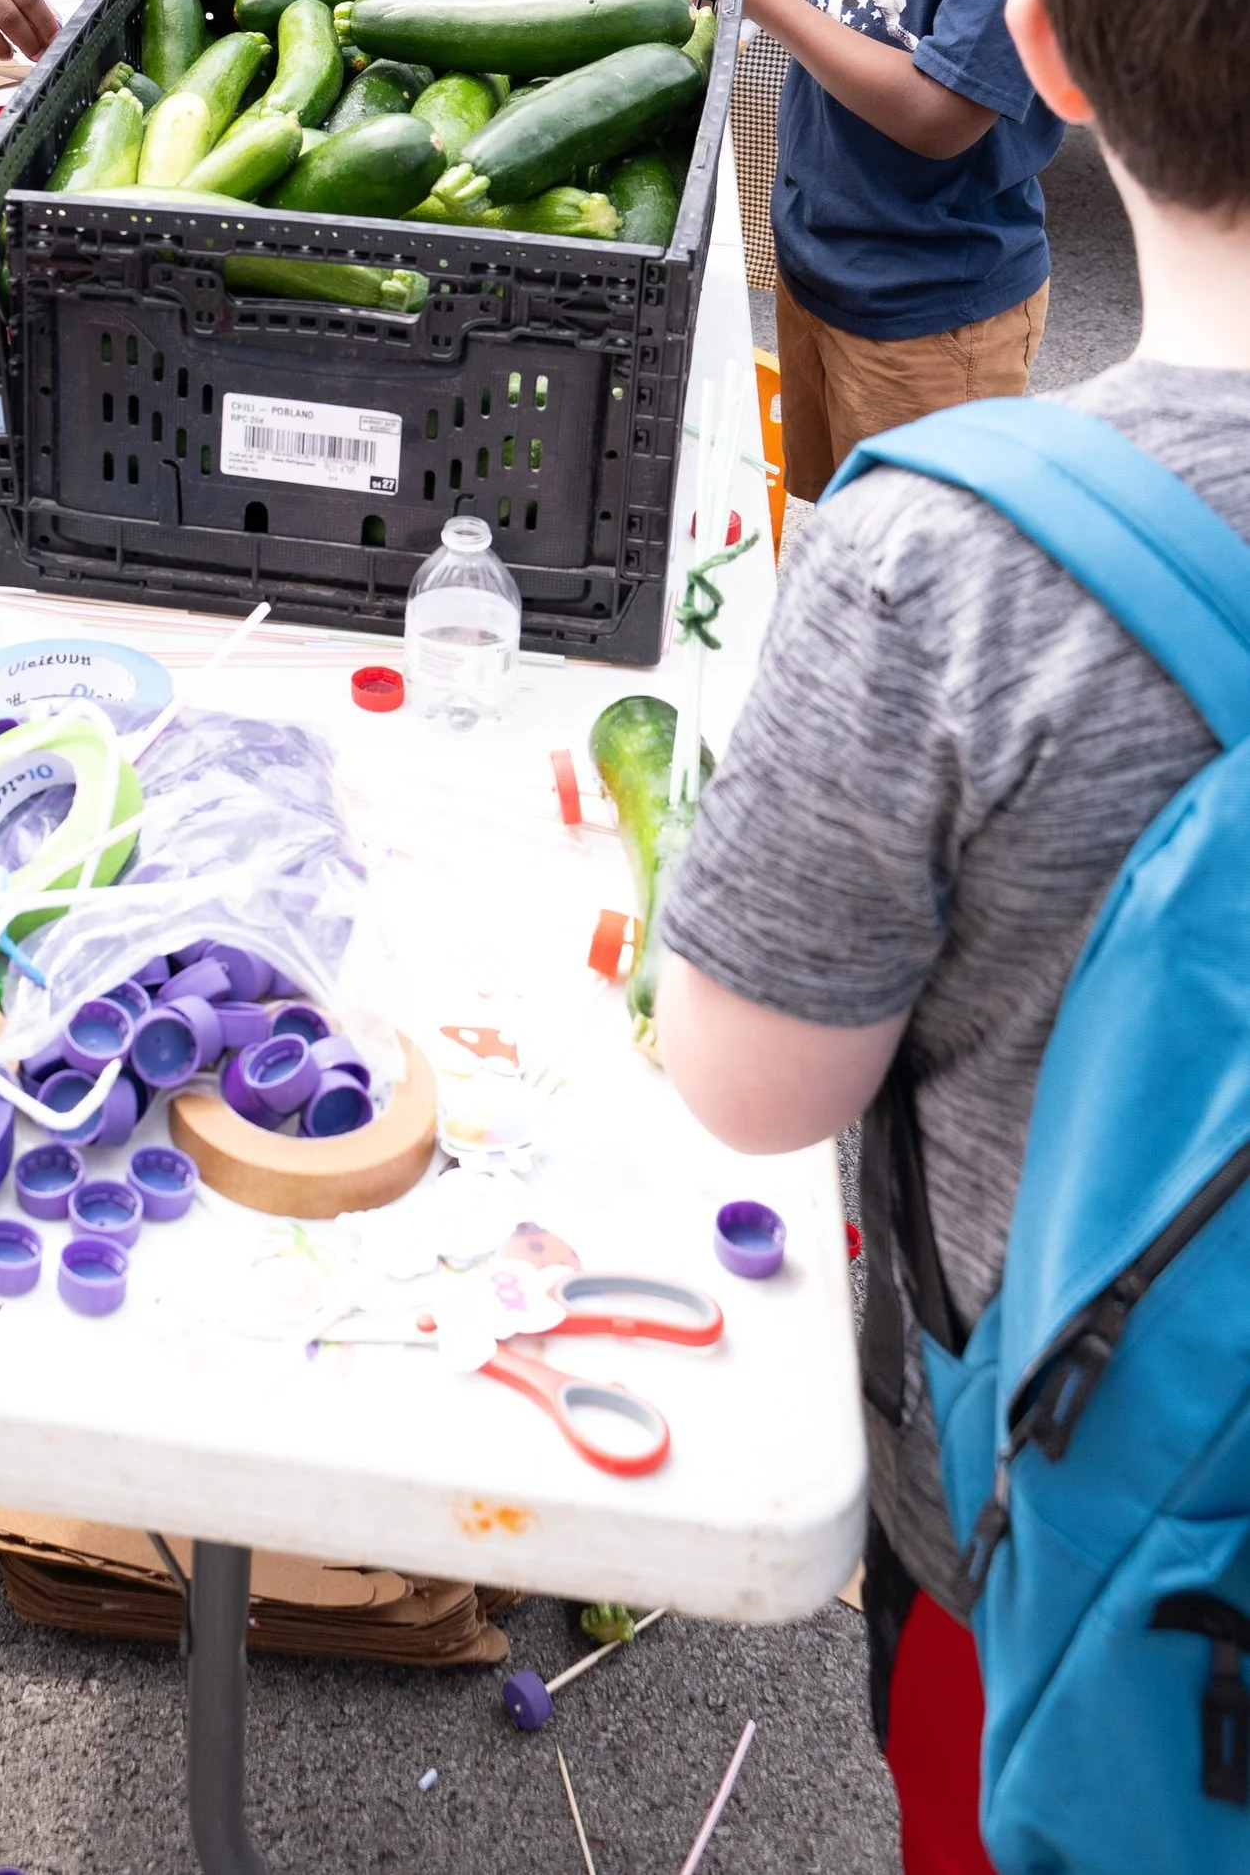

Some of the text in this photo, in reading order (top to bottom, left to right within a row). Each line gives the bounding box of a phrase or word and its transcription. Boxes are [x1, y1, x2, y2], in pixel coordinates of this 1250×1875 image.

[231, 401, 255, 412] CHILI
[271, 407, 314, 420] POBLANO
[230, 414, 248, 424] RPC
